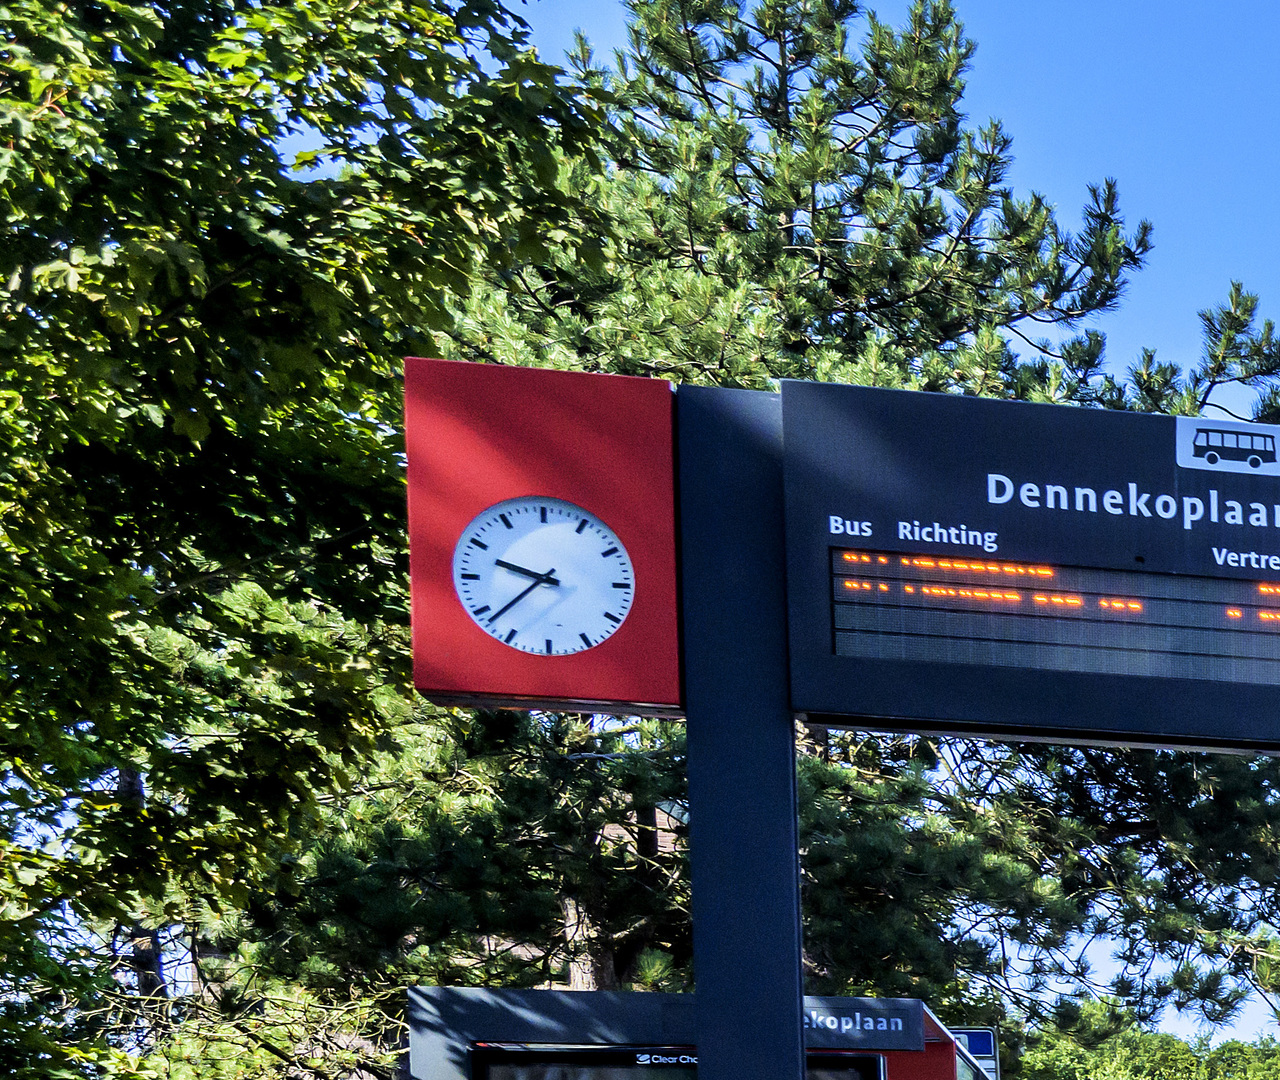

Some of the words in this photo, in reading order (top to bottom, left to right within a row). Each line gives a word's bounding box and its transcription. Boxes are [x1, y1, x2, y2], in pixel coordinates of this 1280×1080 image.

[829, 515, 873, 538] Bus
[898, 521, 998, 552] Richting
[651, 1055, 680, 1064] Clear
